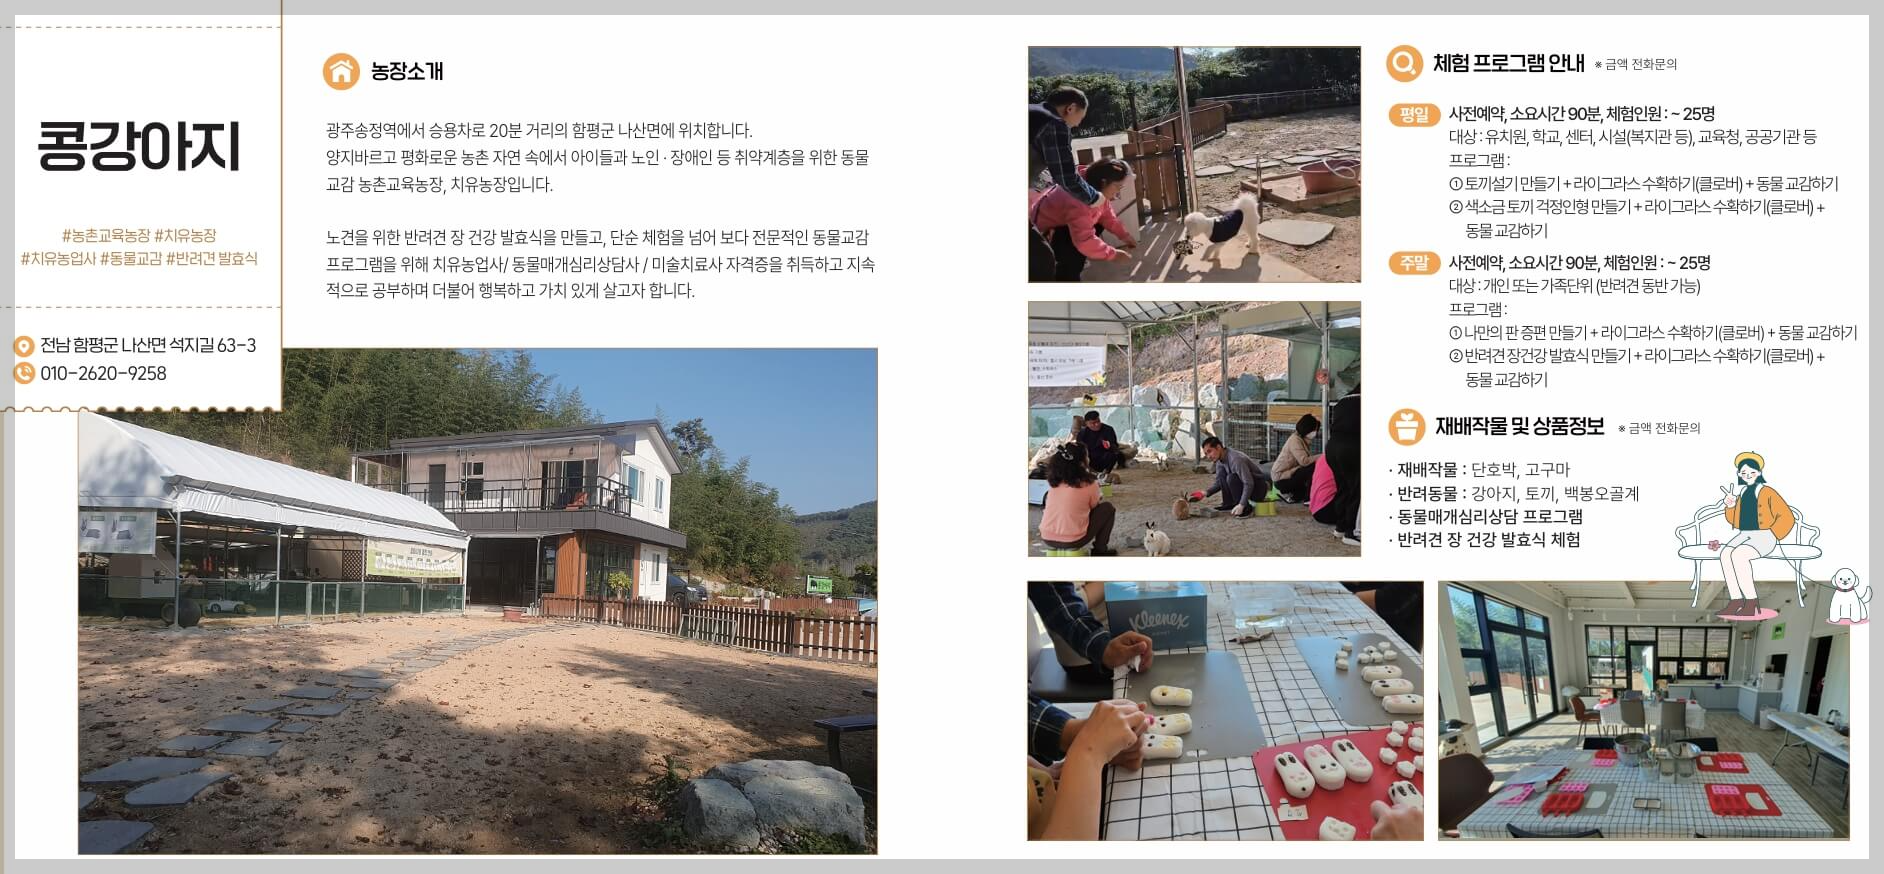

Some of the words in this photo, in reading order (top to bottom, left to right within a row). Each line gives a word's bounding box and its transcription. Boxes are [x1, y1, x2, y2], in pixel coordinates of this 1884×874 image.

[370, 61, 444, 82] 농장소개
[1433, 52, 1470, 73] 체험
[1472, 53, 1545, 73] 프로그램
[1548, 53, 1585, 73] 안내
[1605, 57, 1628, 71] 금액
[1631, 57, 1677, 71] 전화문의
[1400, 106, 1429, 124] 평일
[1448, 105, 1508, 125] 사전예약,
[1509, 104, 1567, 123] 소요시간
[1567, 105, 1605, 125] 90분,
[1605, 104, 1662, 123] 체험인원
[1682, 105, 1715, 123] 25명
[325, 121, 425, 140] 광주송정역에서
[428, 121, 486, 140] 승용차로
[488, 122, 523, 139] 20분
[525, 121, 568, 140] 거리의
[571, 121, 615, 140] 함평군
[618, 121, 675, 140] 나산면에
[677, 121, 753, 140] 위치합니다.
[1449, 128, 1478, 145] 대상
[1484, 127, 1530, 148] 유치원,
[1531, 128, 1563, 148] 학교,
[1565, 128, 1597, 148] 센터,
[1598, 128, 1673, 148] 시설(복지관
[1674, 129, 1696, 148] 등),
[1697, 128, 1743, 148] 교육청,
[1744, 128, 1802, 146] 공공기관
[1802, 129, 1818, 145] 등
[37, 120, 240, 172] 콩강아지
[326, 148, 398, 167] 양지바르고
[400, 148, 458, 167] 평화로운
[460, 148, 490, 167] 농촌
[492, 148, 521, 166] 자연
[524, 148, 567, 167] 속에서
[570, 148, 629, 167] 아이들과
[631, 148, 660, 166] 노인
[670, 148, 713, 167] 장애인
[716, 149, 732, 167] 등
[734, 148, 806, 167] 취약계층을
[808, 148, 839, 167] 위한
[840, 149, 870, 167] 동물
[1448, 152, 1505, 169] 프로그램
[325, 175, 356, 193] 교감
[357, 175, 447, 196] 농촌교육농장,
[450, 175, 553, 194] 치유농장입니다.
[1464, 175, 1518, 193] 토끼설기
[1520, 175, 1560, 193] 만들기
[1573, 175, 1641, 193] 라이그라스
[1641, 175, 1744, 195] 수확하기(클로버)
[1755, 175, 1785, 193] 동물
[1784, 175, 1839, 193] 교감하기
[1464, 198, 1506, 216] 색소금
[1506, 198, 1534, 216] 토끼
[1535, 198, 1589, 216] 걱정인형
[1591, 198, 1631, 216] 만들기
[1644, 198, 1713, 216] 라이그라스
[1712, 198, 1814, 218] 수확하기(클로버)
[62, 227, 152, 244] #농촌교육농장
[153, 228, 217, 244] #치유농장
[325, 228, 369, 247] 노견을
[371, 228, 402, 247] 위한
[404, 228, 447, 247] 반려견
[450, 228, 466, 247] 장
[468, 228, 498, 247] 건강
[500, 228, 557, 247] 발효식을
[560, 228, 607, 249] 만들고,
[610, 228, 639, 246] 단순
[642, 228, 685, 247] 체험을
[688, 228, 716, 247] 넘어
[719, 228, 750, 247] 보다
[752, 228, 809, 247] 전문적인
[812, 228, 870, 247] 동물교감
[1465, 222, 1494, 240] 동물
[1494, 222, 1548, 240] 교감하기
[20, 251, 97, 267] #치유농업사
[99, 251, 163, 267] #동물교감
[165, 251, 216, 266] #반려견
[218, 251, 258, 266] 발효식
[325, 255, 398, 273] 프로그램을
[400, 255, 429, 274] 위해
[432, 255, 509, 274] 치유농업사/
[511, 255, 641, 274] 동물매개심리상담사
[652, 255, 724, 274] 미술치료사
[725, 255, 783, 274] 자격증을
[786, 255, 844, 273] 취득하고
[846, 255, 876, 274] 지속
[1399, 254, 1431, 272] 주말
[1448, 254, 1506, 274] 사전예약,
[1508, 254, 1564, 272] 소요시간
[1565, 254, 1601, 274] 90분,
[1603, 254, 1658, 272] 체험인원
[1679, 254, 1711, 272] 25명
[326, 281, 369, 300] 적으로
[371, 281, 428, 300] 공부하며
[432, 281, 475, 300] 더불어
[478, 281, 536, 300] 행복하고
[538, 281, 567, 300] 가치
[571, 281, 599, 300] 있게
[602, 281, 647, 300] 살고자
[648, 281, 695, 300] 합니다.
[1449, 277, 1477, 295] 대상
[1483, 277, 1510, 295] 개인
[1511, 277, 1540, 294] 또는
[1540, 277, 1593, 295] 가족단위
[1595, 277, 1640, 297] (반려견
[1641, 277, 1670, 295] 동반
[1670, 277, 1701, 297] 가능)
[1448, 301, 1502, 318] 프로그램
[1464, 324, 1503, 341] 나만의
[1504, 324, 1520, 341] 판
[1520, 324, 1547, 342] 증편
[1548, 324, 1587, 342] 만들기
[1601, 324, 1666, 342] 라이그라스
[1666, 324, 1765, 344] 수확하기(클로버)
[1777, 324, 1805, 342] 동물
[1805, 324, 1858, 342] 교감하기
[40, 336, 72, 354] 전남
[73, 336, 119, 354] 함평군
[121, 336, 167, 354] 나산면
[168, 336, 215, 354] 석지길
[217, 337, 257, 353] 63-3
[1464, 347, 1505, 365] 반려견
[1549, 347, 1589, 365] 발효식
[1591, 347, 1631, 365] 만들기
[1644, 347, 1712, 365] 라이그라스
[1712, 347, 1814, 367] 수확하기(클로버)
[40, 365, 167, 381] 010-2620-9258
[1465, 371, 1494, 389] 동물
[1494, 371, 1548, 389] 교감하기
[1435, 416, 1509, 437] 재배작물
[1511, 416, 1530, 436] 및
[1532, 416, 1606, 437] 상품정보
[1628, 421, 1652, 435] 금액
[1655, 421, 1701, 435] 전화문의
[1397, 461, 1458, 479] 재배작물
[1471, 461, 1521, 481] 단호박,
[1524, 461, 1571, 479] 고구마
[1397, 485, 1458, 503] 반려동물
[1471, 485, 1521, 505] 강아지,
[1525, 485, 1559, 505] 토끼,
[1564, 485, 1639, 503] 백봉오골계
[1397, 508, 1519, 526] 동물매개심리상담
[1522, 508, 1583, 526] 프로그램
[1397, 531, 1443, 549] 반려견
[1447, 531, 1463, 549] 장
[1466, 531, 1498, 549] 건강
[1501, 531, 1546, 549] 발효식
[1550, 531, 1580, 549] 체험
[1129, 609, 1190, 633] Kleenex
